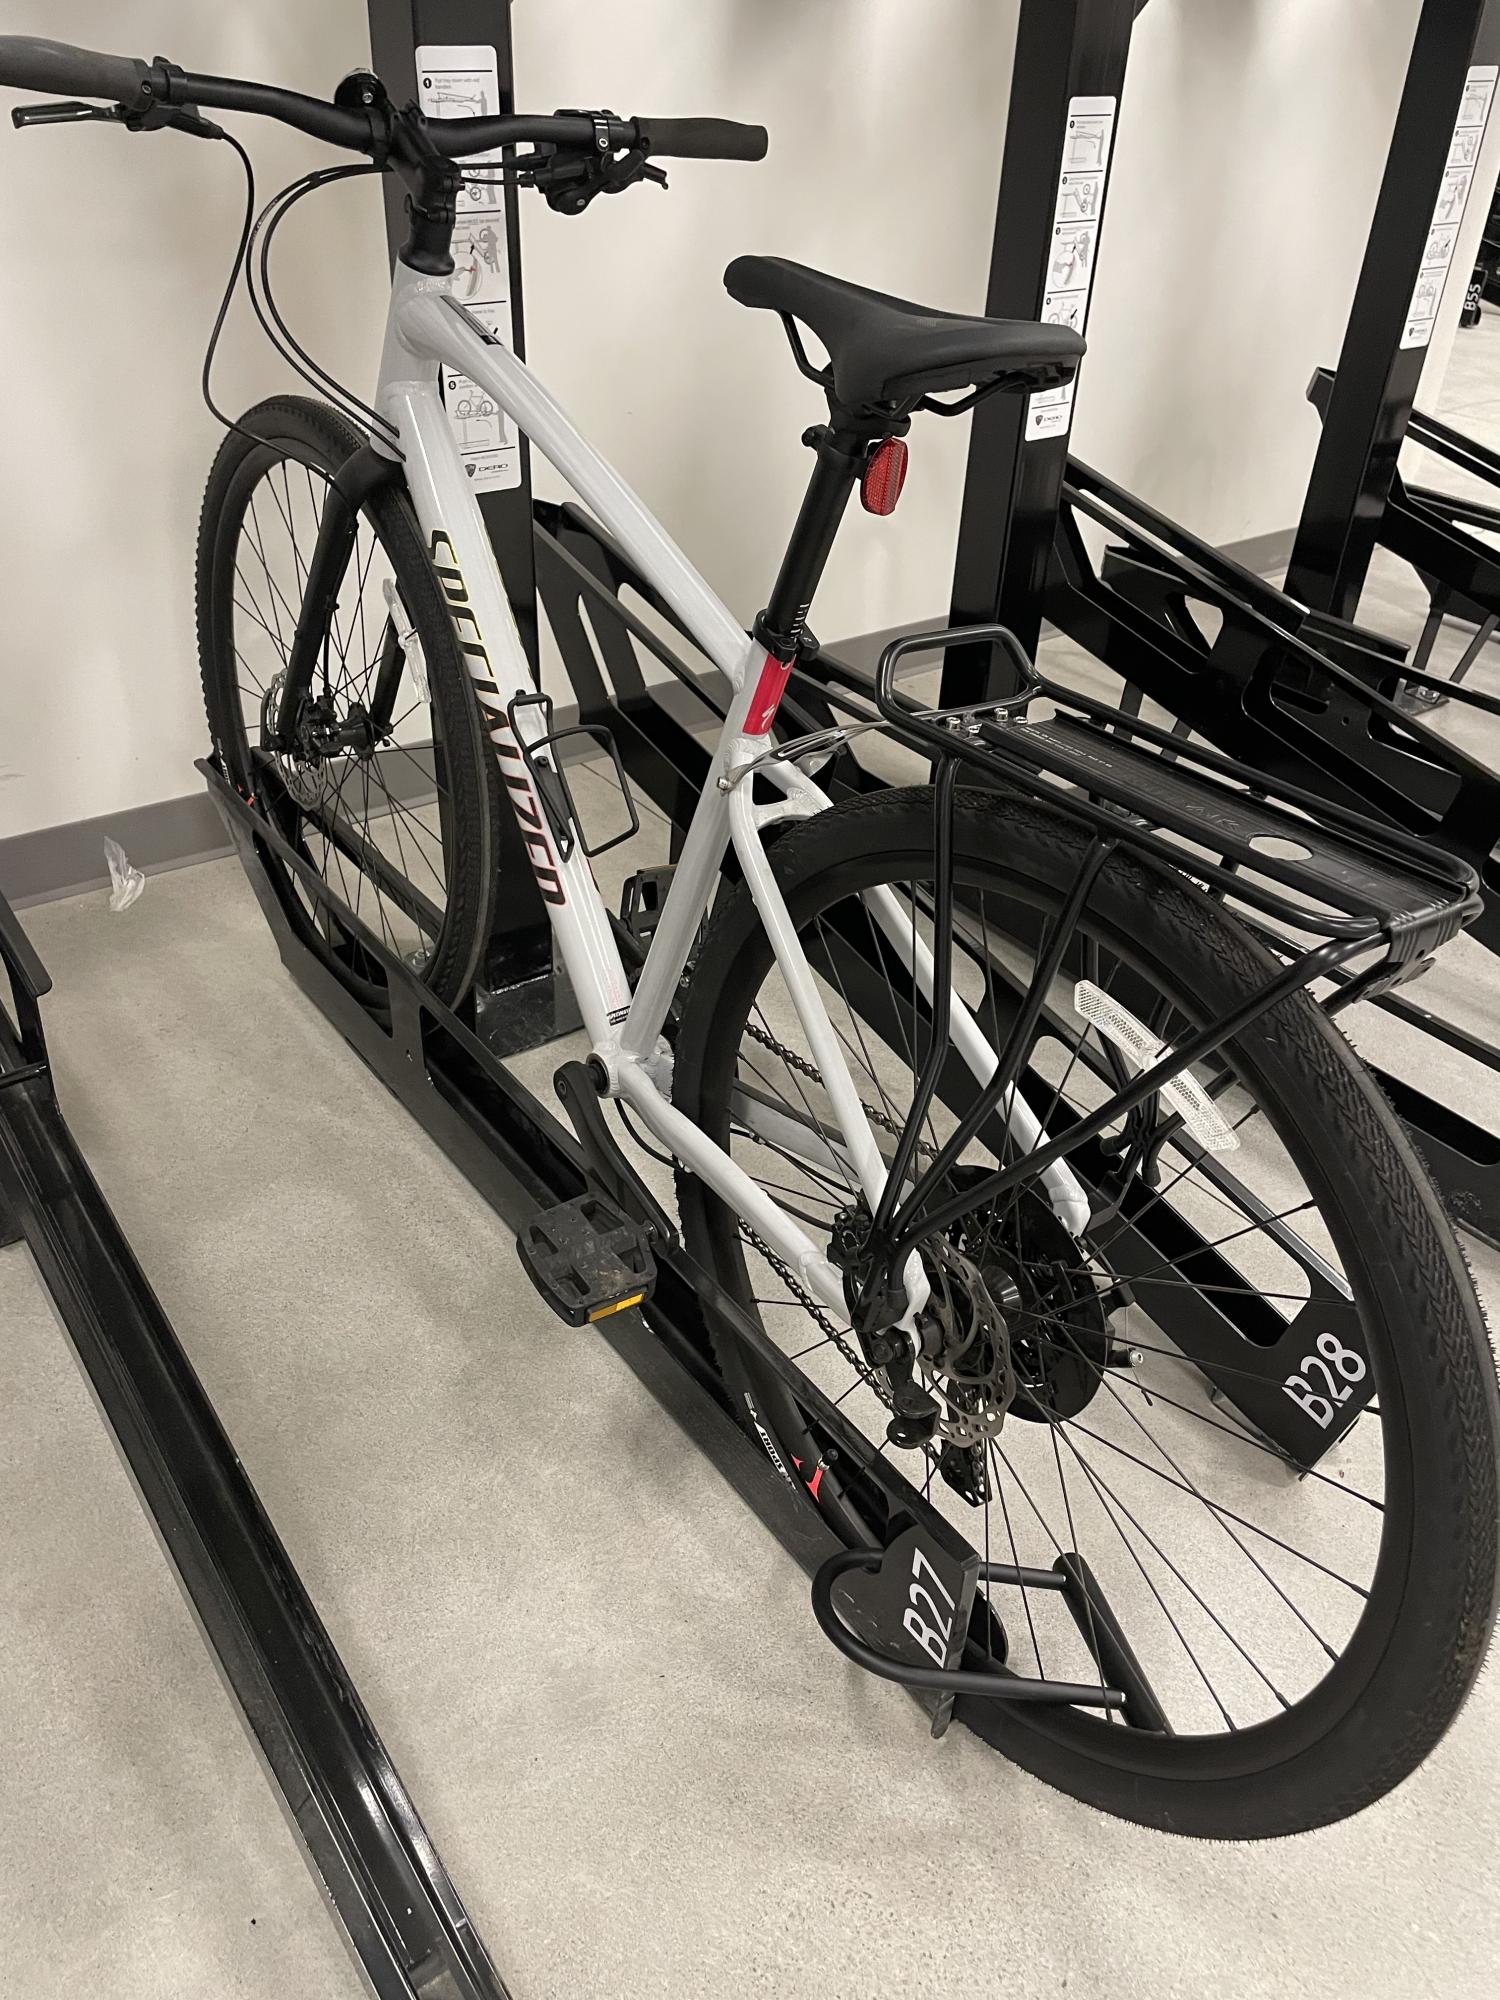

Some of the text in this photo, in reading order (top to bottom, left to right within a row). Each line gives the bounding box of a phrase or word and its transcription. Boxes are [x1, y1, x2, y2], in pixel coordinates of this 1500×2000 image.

[1281, 1332, 1366, 1430] B28
[759, 1431, 784, 1470] SPORT
[902, 1547, 956, 1669] B27
